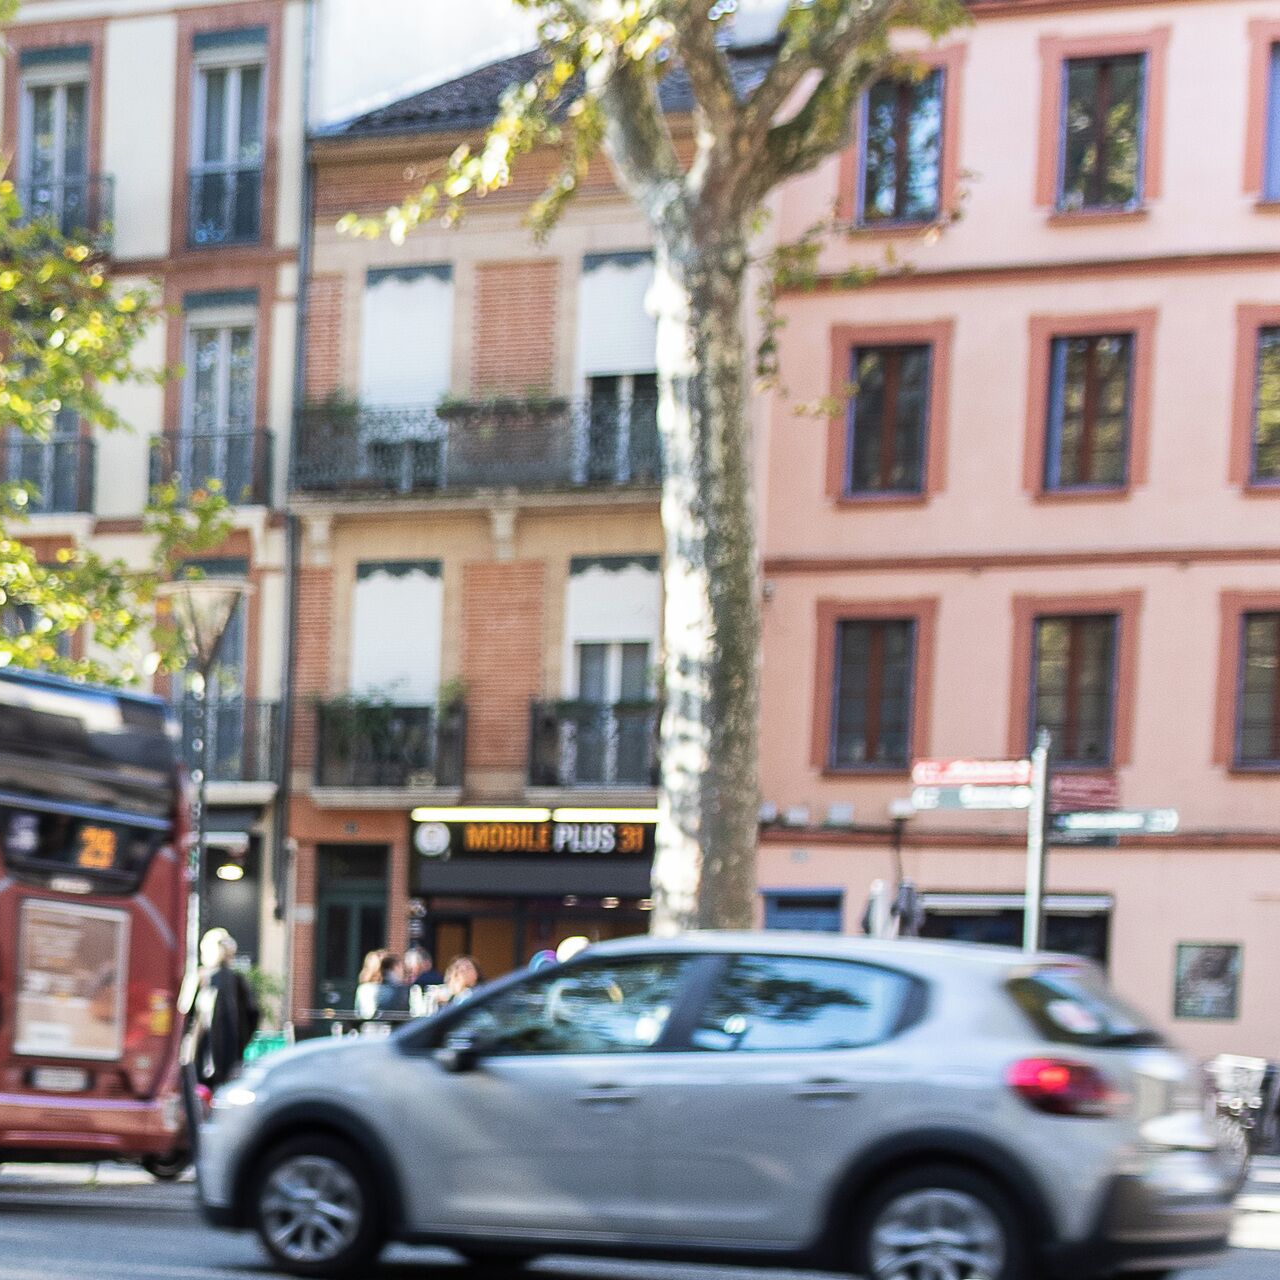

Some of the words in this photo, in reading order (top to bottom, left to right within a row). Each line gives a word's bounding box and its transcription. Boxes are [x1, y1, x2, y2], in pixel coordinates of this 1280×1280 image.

[464, 822, 552, 853] MOBILE
[553, 822, 616, 854] PLUS
[618, 823, 644, 853] 31
